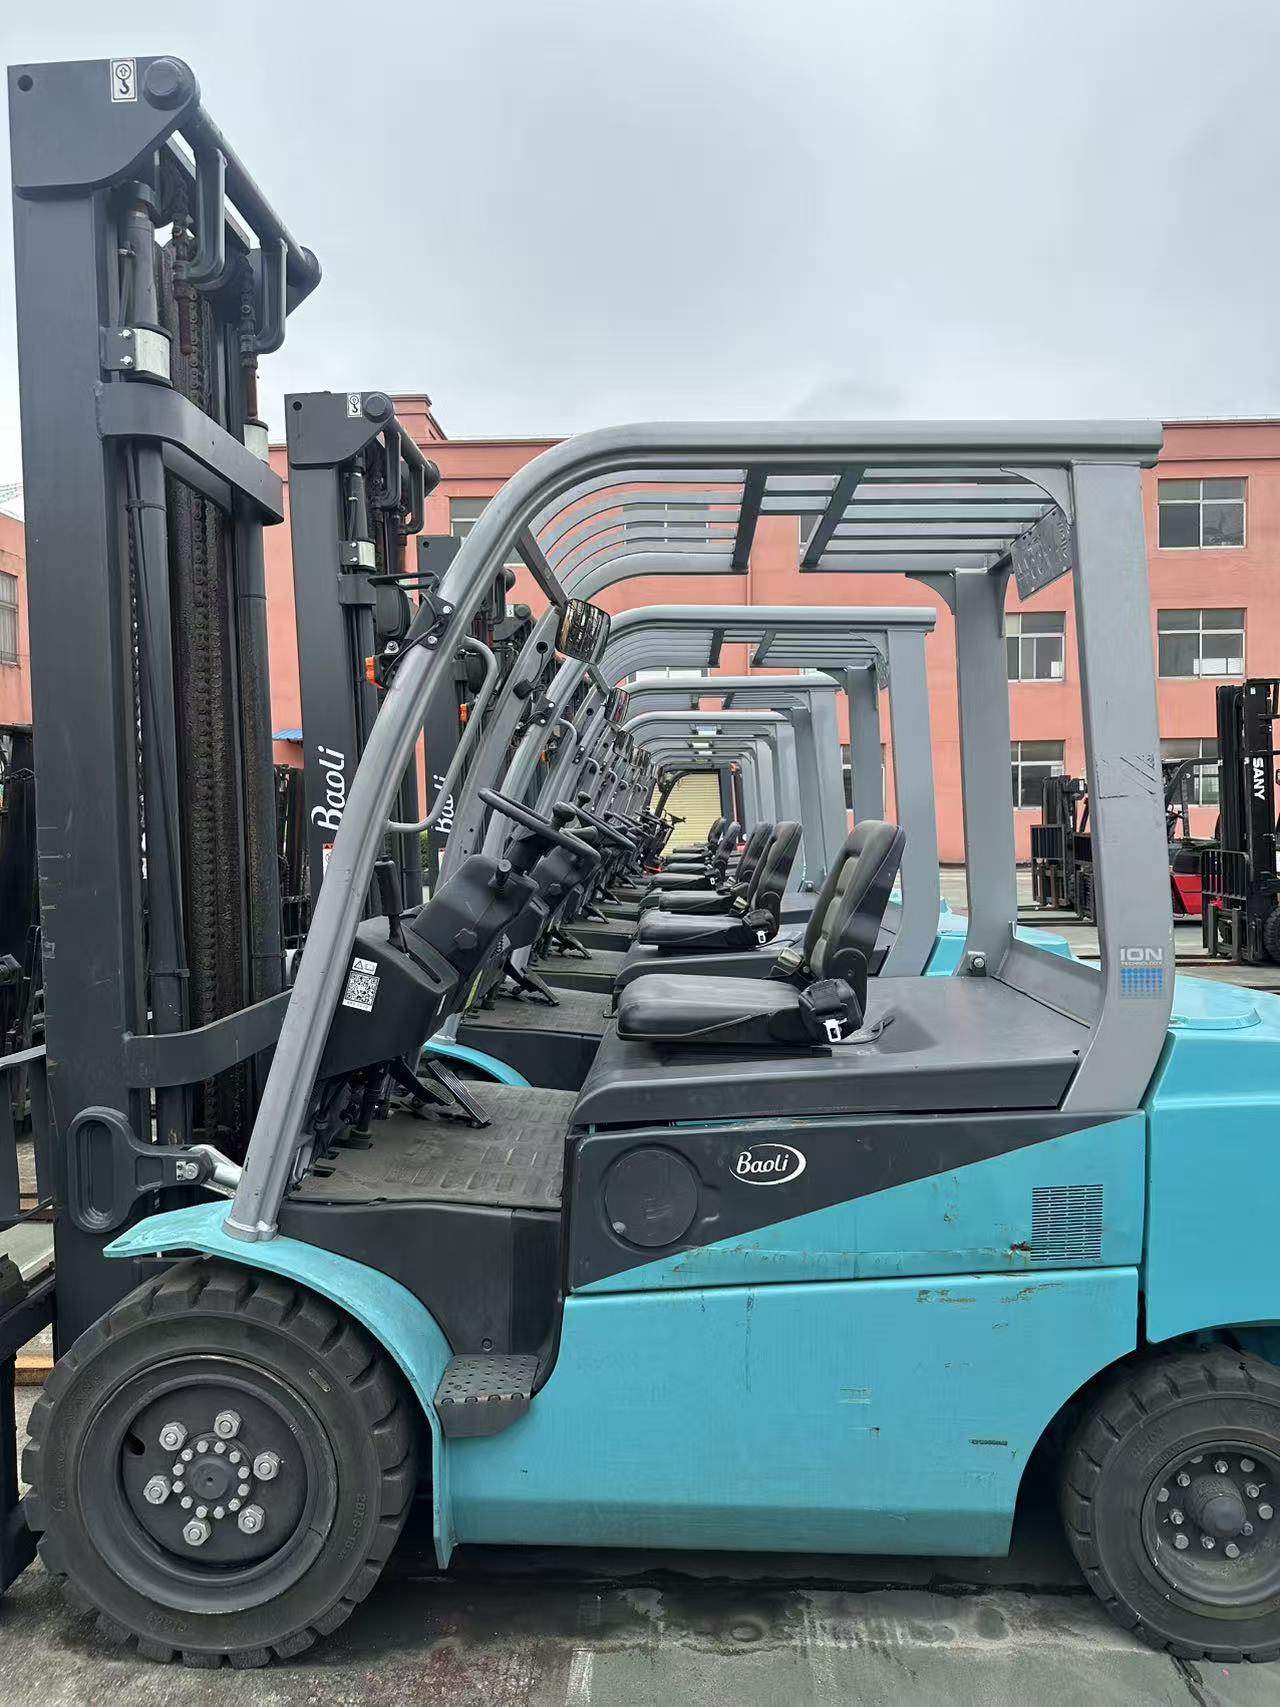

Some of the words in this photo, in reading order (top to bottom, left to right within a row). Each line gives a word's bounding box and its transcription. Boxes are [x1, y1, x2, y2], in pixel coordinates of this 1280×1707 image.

[311, 745, 346, 831] Baoli
[1252, 757, 1266, 801] SANY
[1120, 948, 1163, 961] ION
[736, 1151, 790, 1174] Baoli
